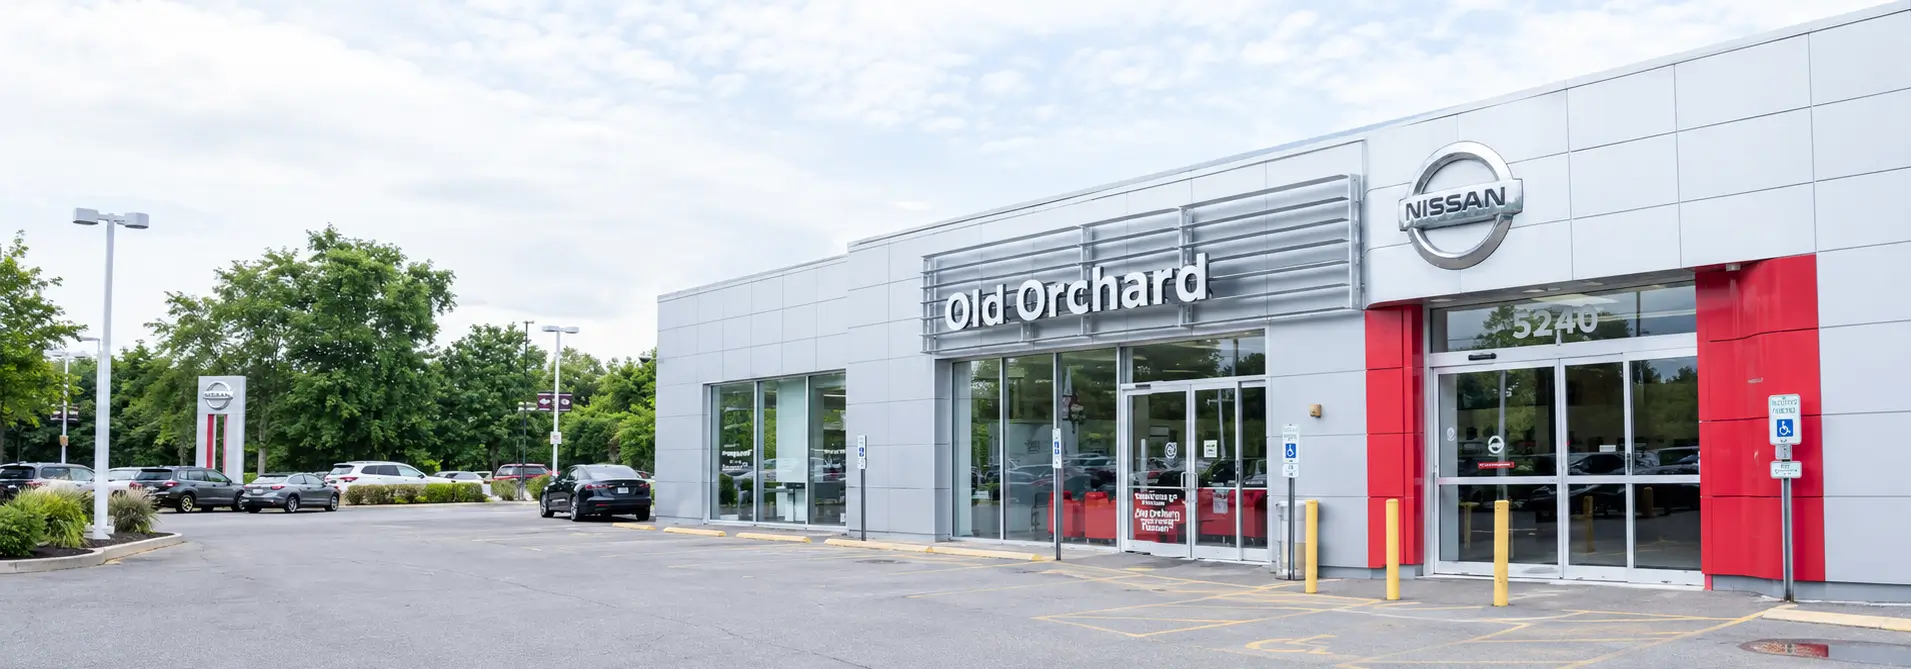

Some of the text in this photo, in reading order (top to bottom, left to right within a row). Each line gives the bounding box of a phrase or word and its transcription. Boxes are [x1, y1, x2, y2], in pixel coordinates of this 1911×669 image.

[1405, 186, 1506, 221] NISSAN
[944, 252, 1209, 331] Old Orchard
[1512, 303, 1599, 339] 5240
